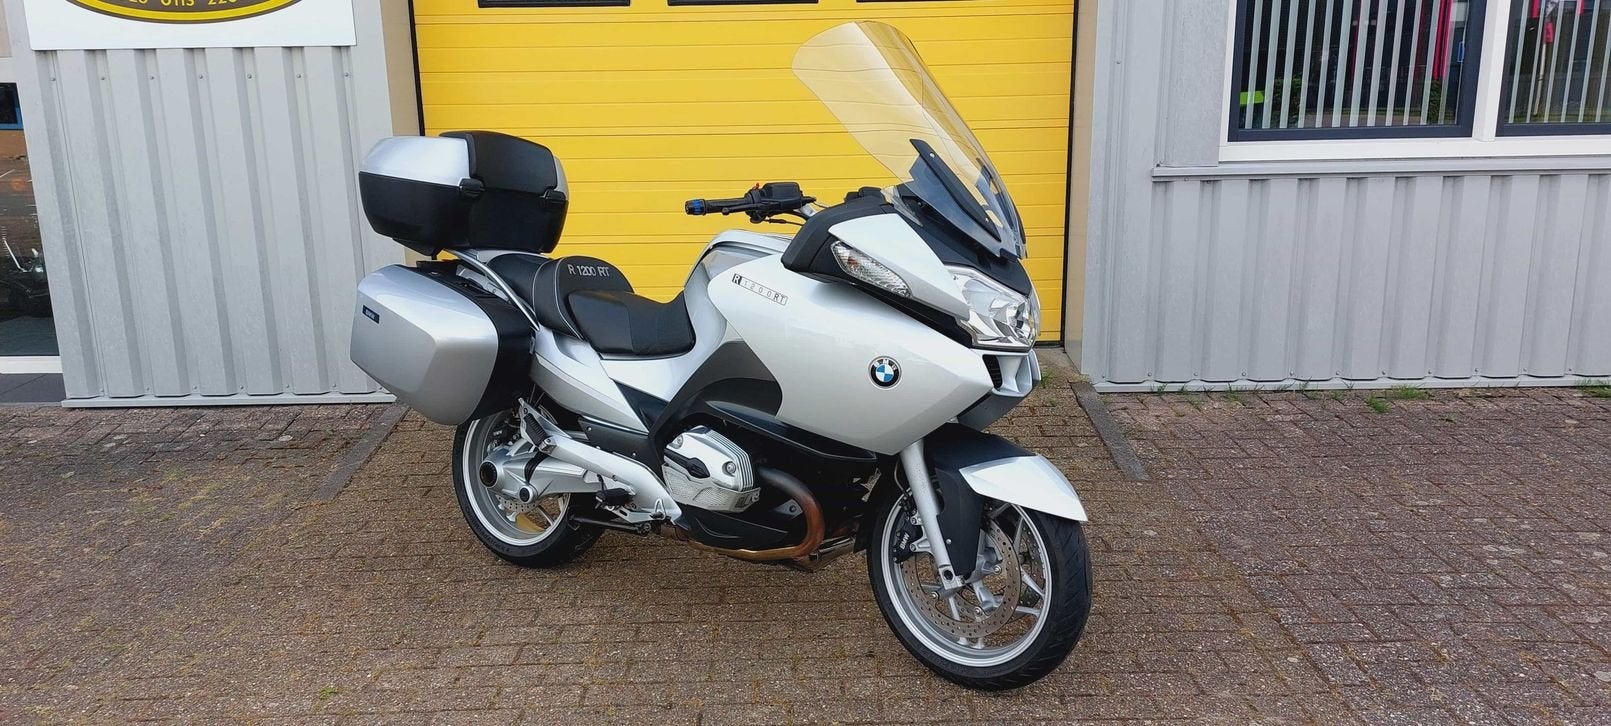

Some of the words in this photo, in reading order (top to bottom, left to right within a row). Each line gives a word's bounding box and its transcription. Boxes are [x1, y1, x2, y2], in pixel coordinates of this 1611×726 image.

[567, 264, 576, 275] R
[576, 265, 597, 277] 1200
[597, 266, 610, 277] RT
[900, 532, 910, 550] BMW
